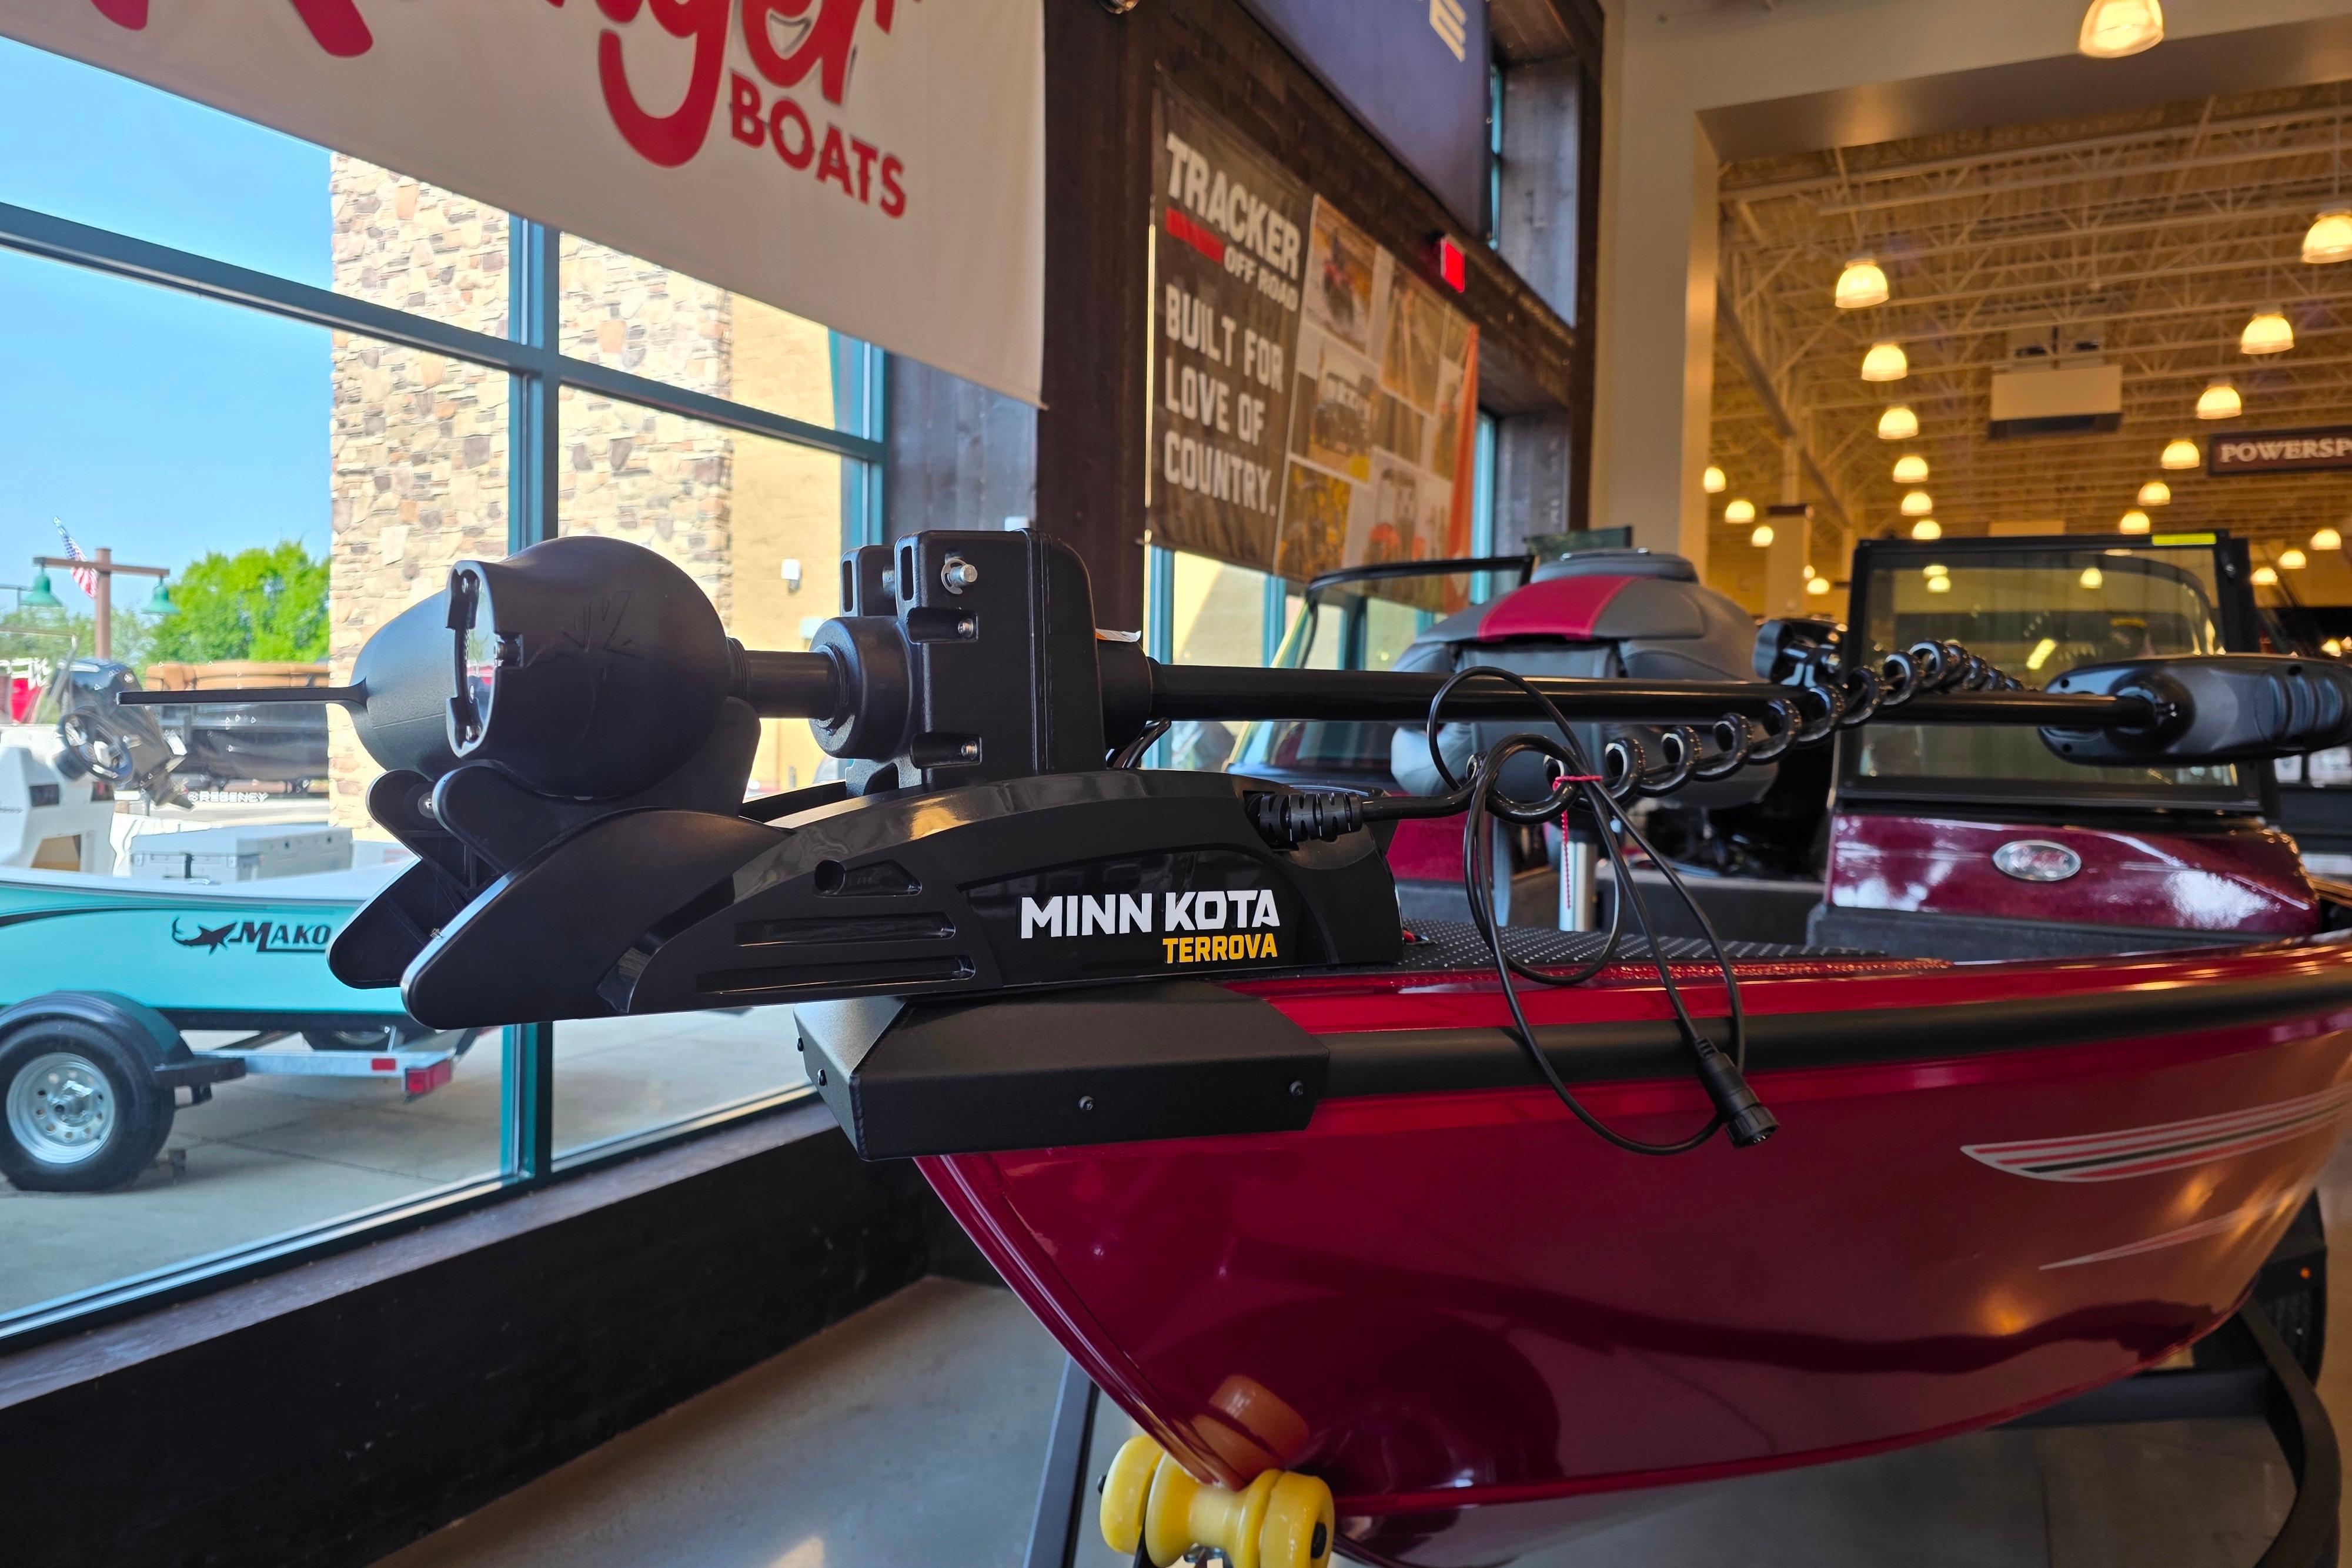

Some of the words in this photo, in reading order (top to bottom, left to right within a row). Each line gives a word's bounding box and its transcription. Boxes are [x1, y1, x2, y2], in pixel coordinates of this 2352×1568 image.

[729, 68, 908, 219] BOATS
[1166, 131, 1301, 281] TRACKER
[1224, 244, 1256, 283] OFF
[1165, 283, 1236, 367] BUILT
[1244, 328, 1284, 393] FOR
[1165, 356, 1230, 433] LOVE
[1238, 393, 1265, 446] OF
[1164, 430, 1277, 517] COUNTRY.
[228, 921, 331, 952] MAKO
[1021, 892, 1152, 939] MINN
[1165, 890, 1280, 931] KOTA
[1163, 933, 1278, 964] TERROVA
